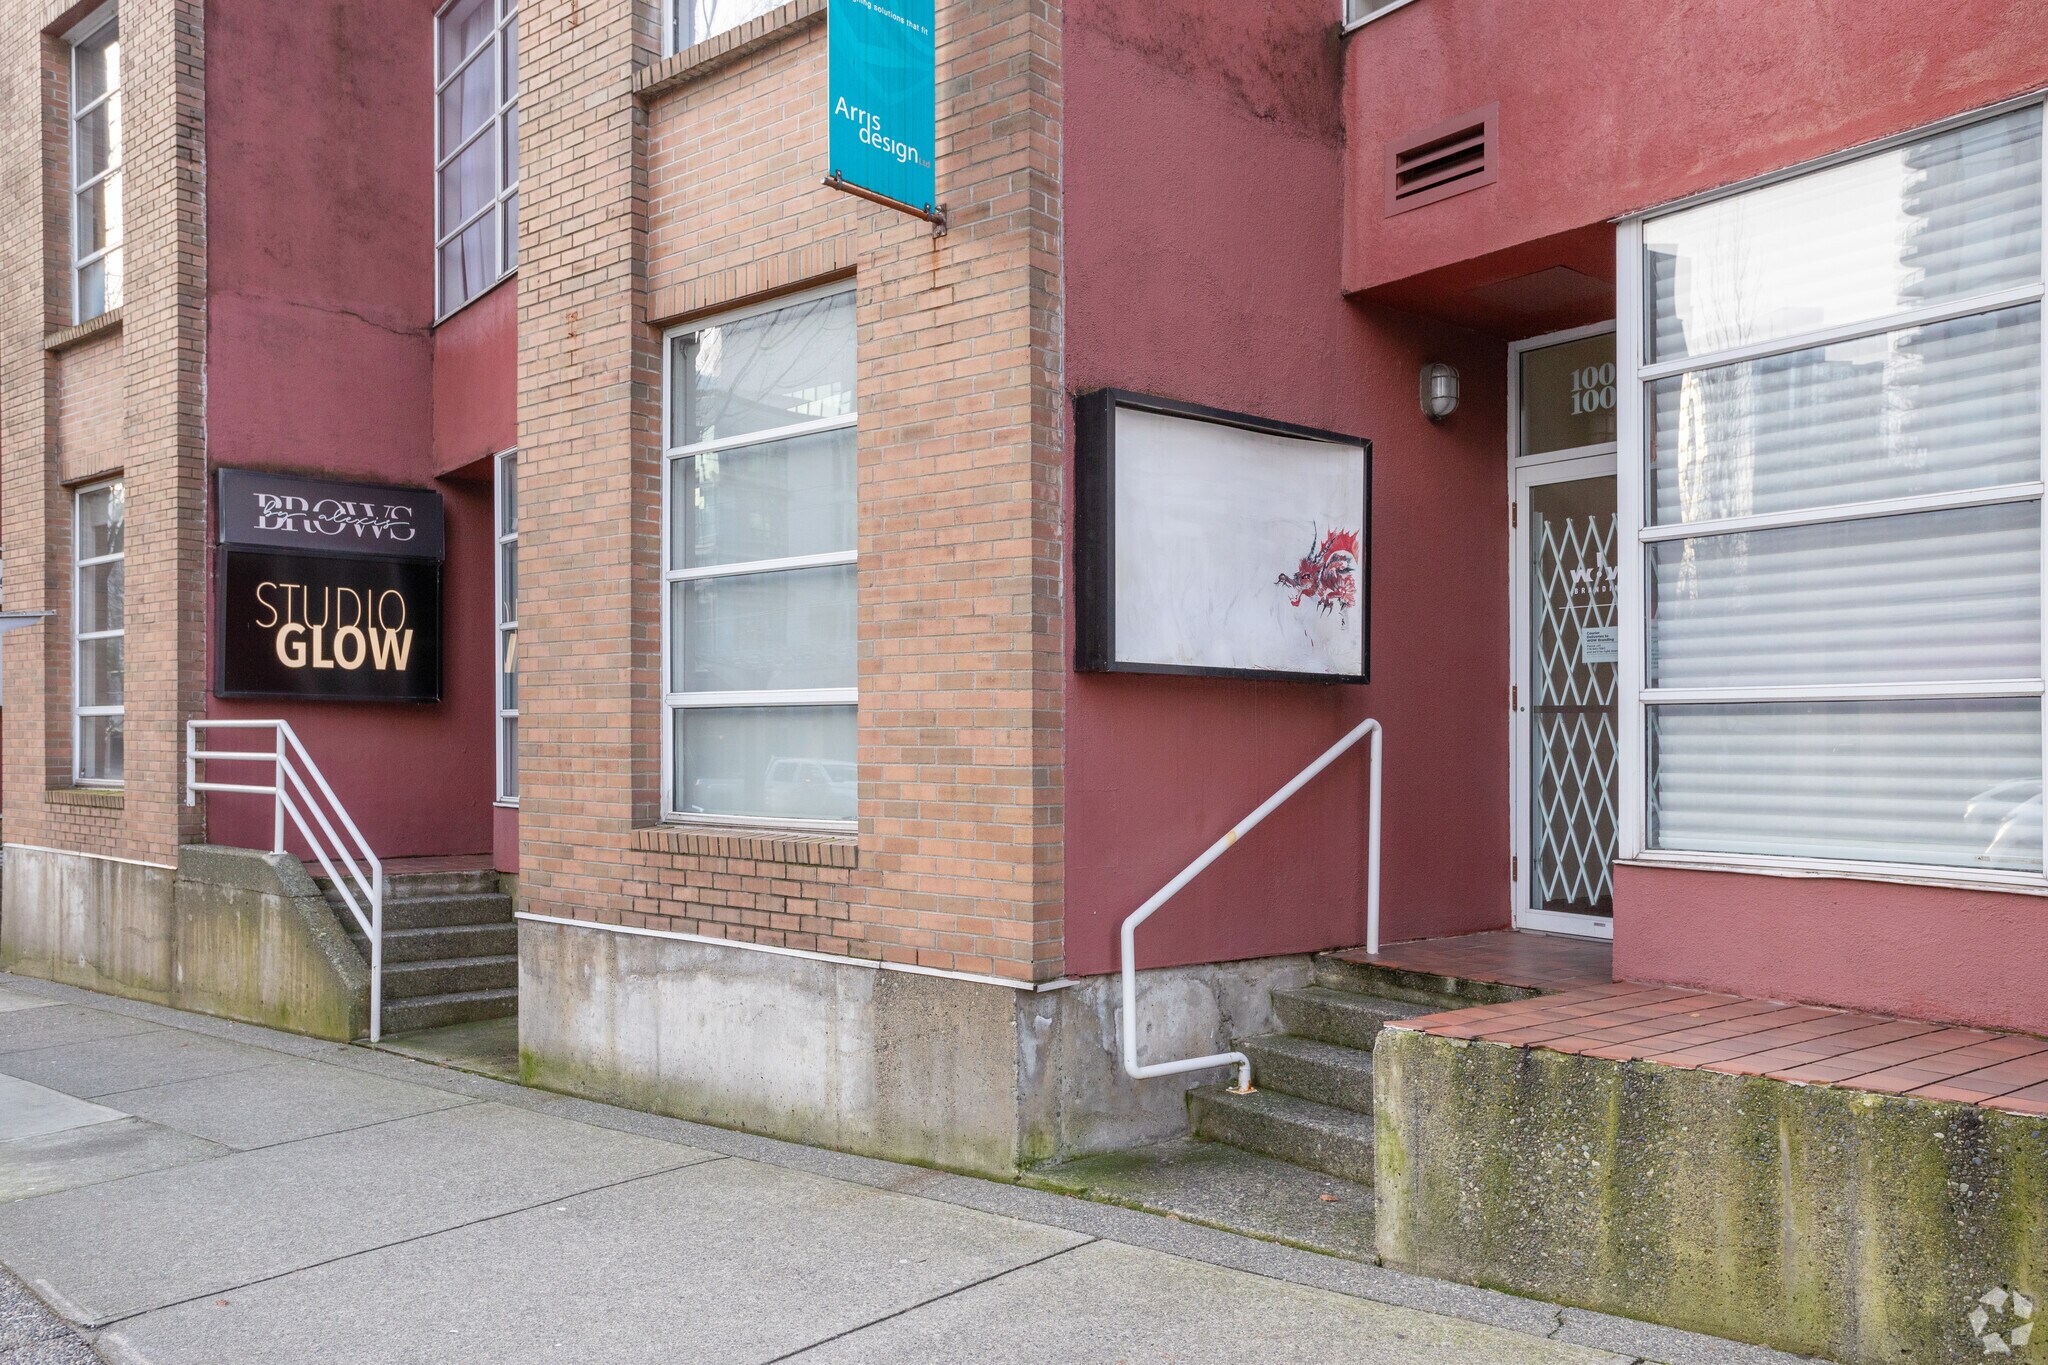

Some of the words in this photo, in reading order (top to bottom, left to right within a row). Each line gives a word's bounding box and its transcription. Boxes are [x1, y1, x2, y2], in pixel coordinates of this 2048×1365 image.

[873, 4, 905, 24] solutions
[906, 19, 920, 32] that
[921, 26, 929, 36] fit
[835, 96, 881, 131] Arris
[859, 116, 919, 163] design
[1571, 362, 1616, 392] 100
[1571, 385, 1617, 416] 100
[253, 493, 416, 541] BROWS
[263, 500, 307, 520] by
[318, 508, 410, 530] alexis
[255, 581, 406, 633] STUDIO
[276, 622, 414, 671] GLOW
